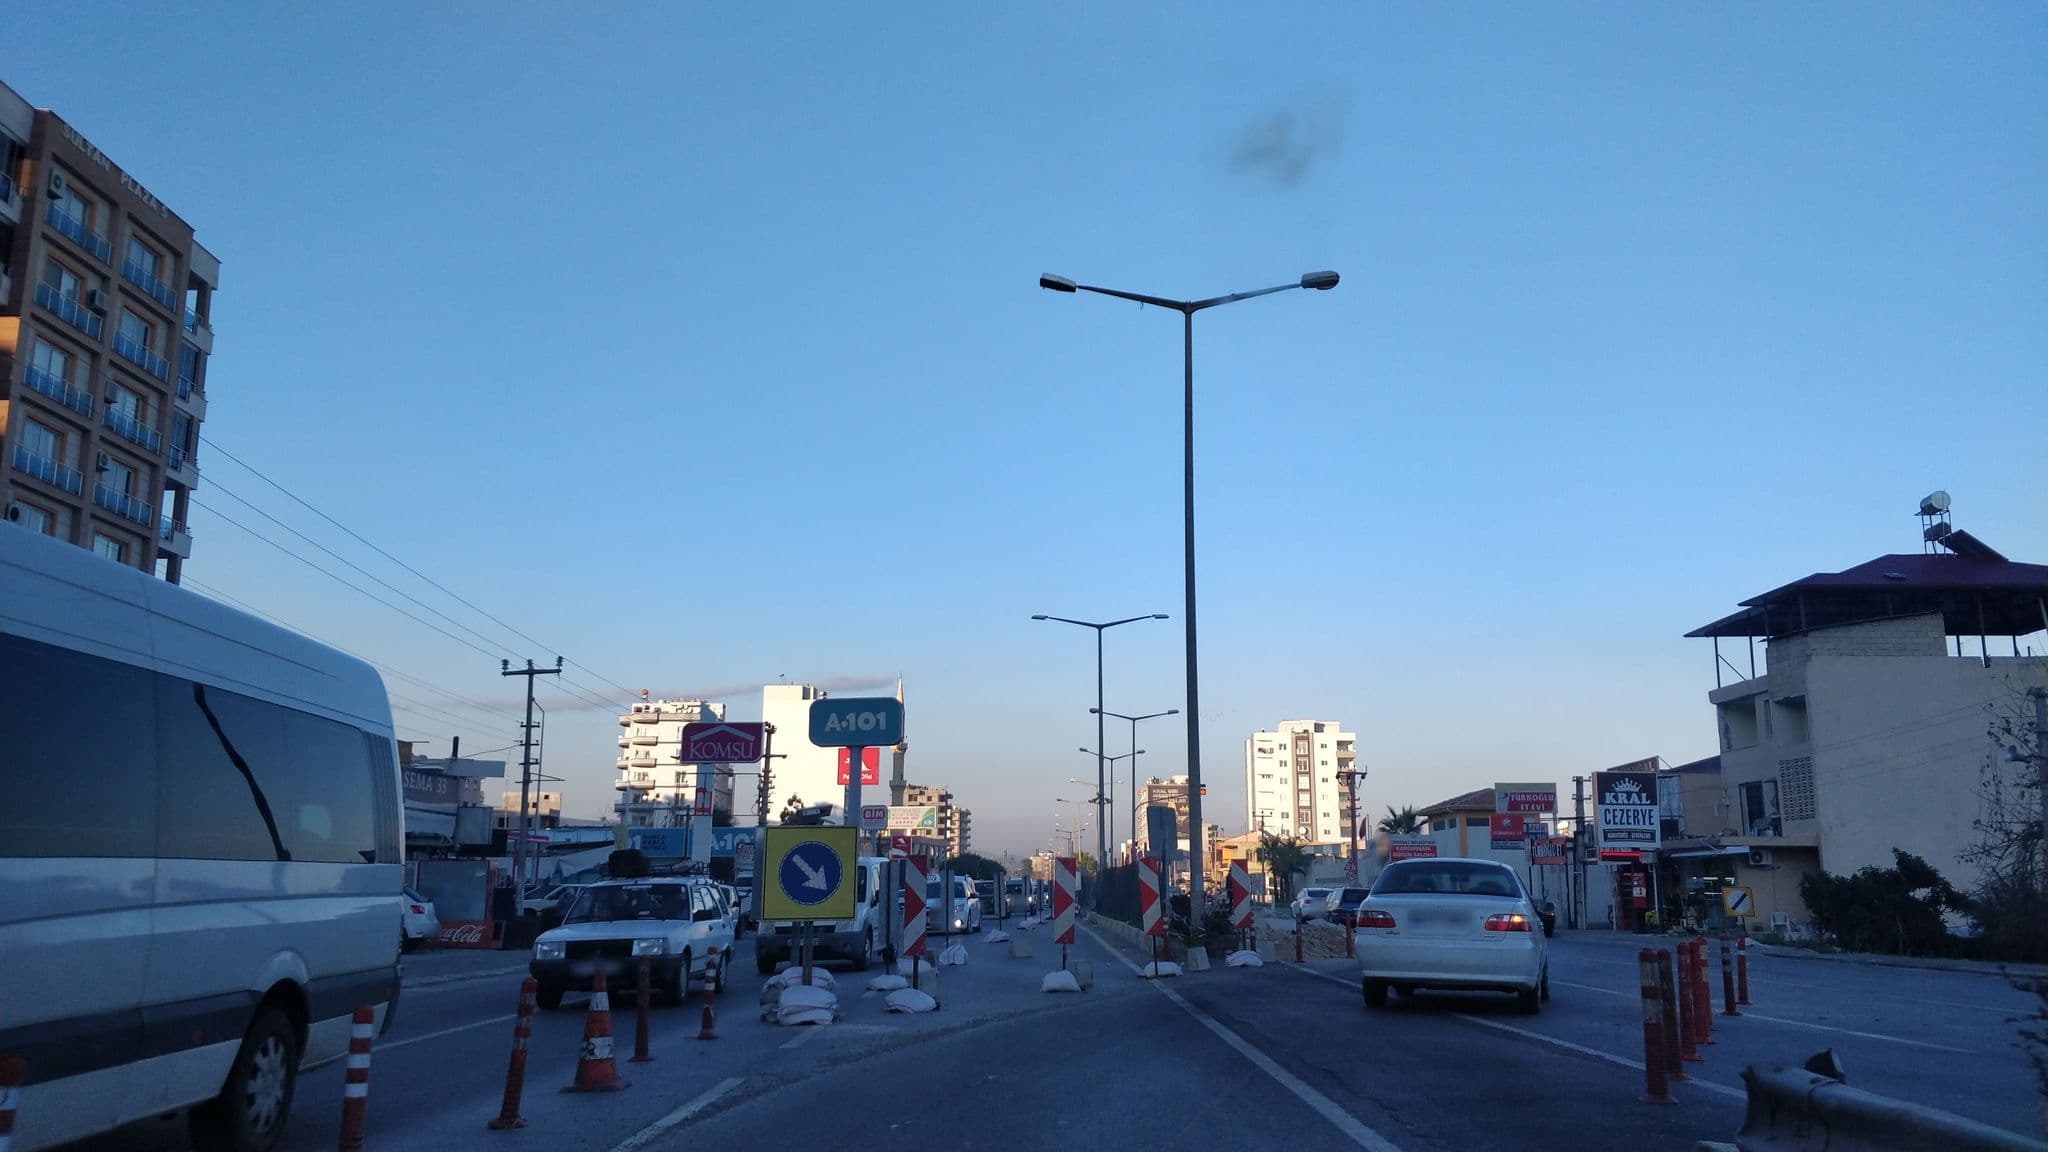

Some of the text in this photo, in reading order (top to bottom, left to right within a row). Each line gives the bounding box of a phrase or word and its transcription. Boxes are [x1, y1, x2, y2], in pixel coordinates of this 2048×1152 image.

[689, 741, 755, 761] KOMŞU
[403, 769, 433, 792] SEMA
[1604, 792, 1651, 805] KRAL
[1603, 808, 1655, 826] CEZERYE
